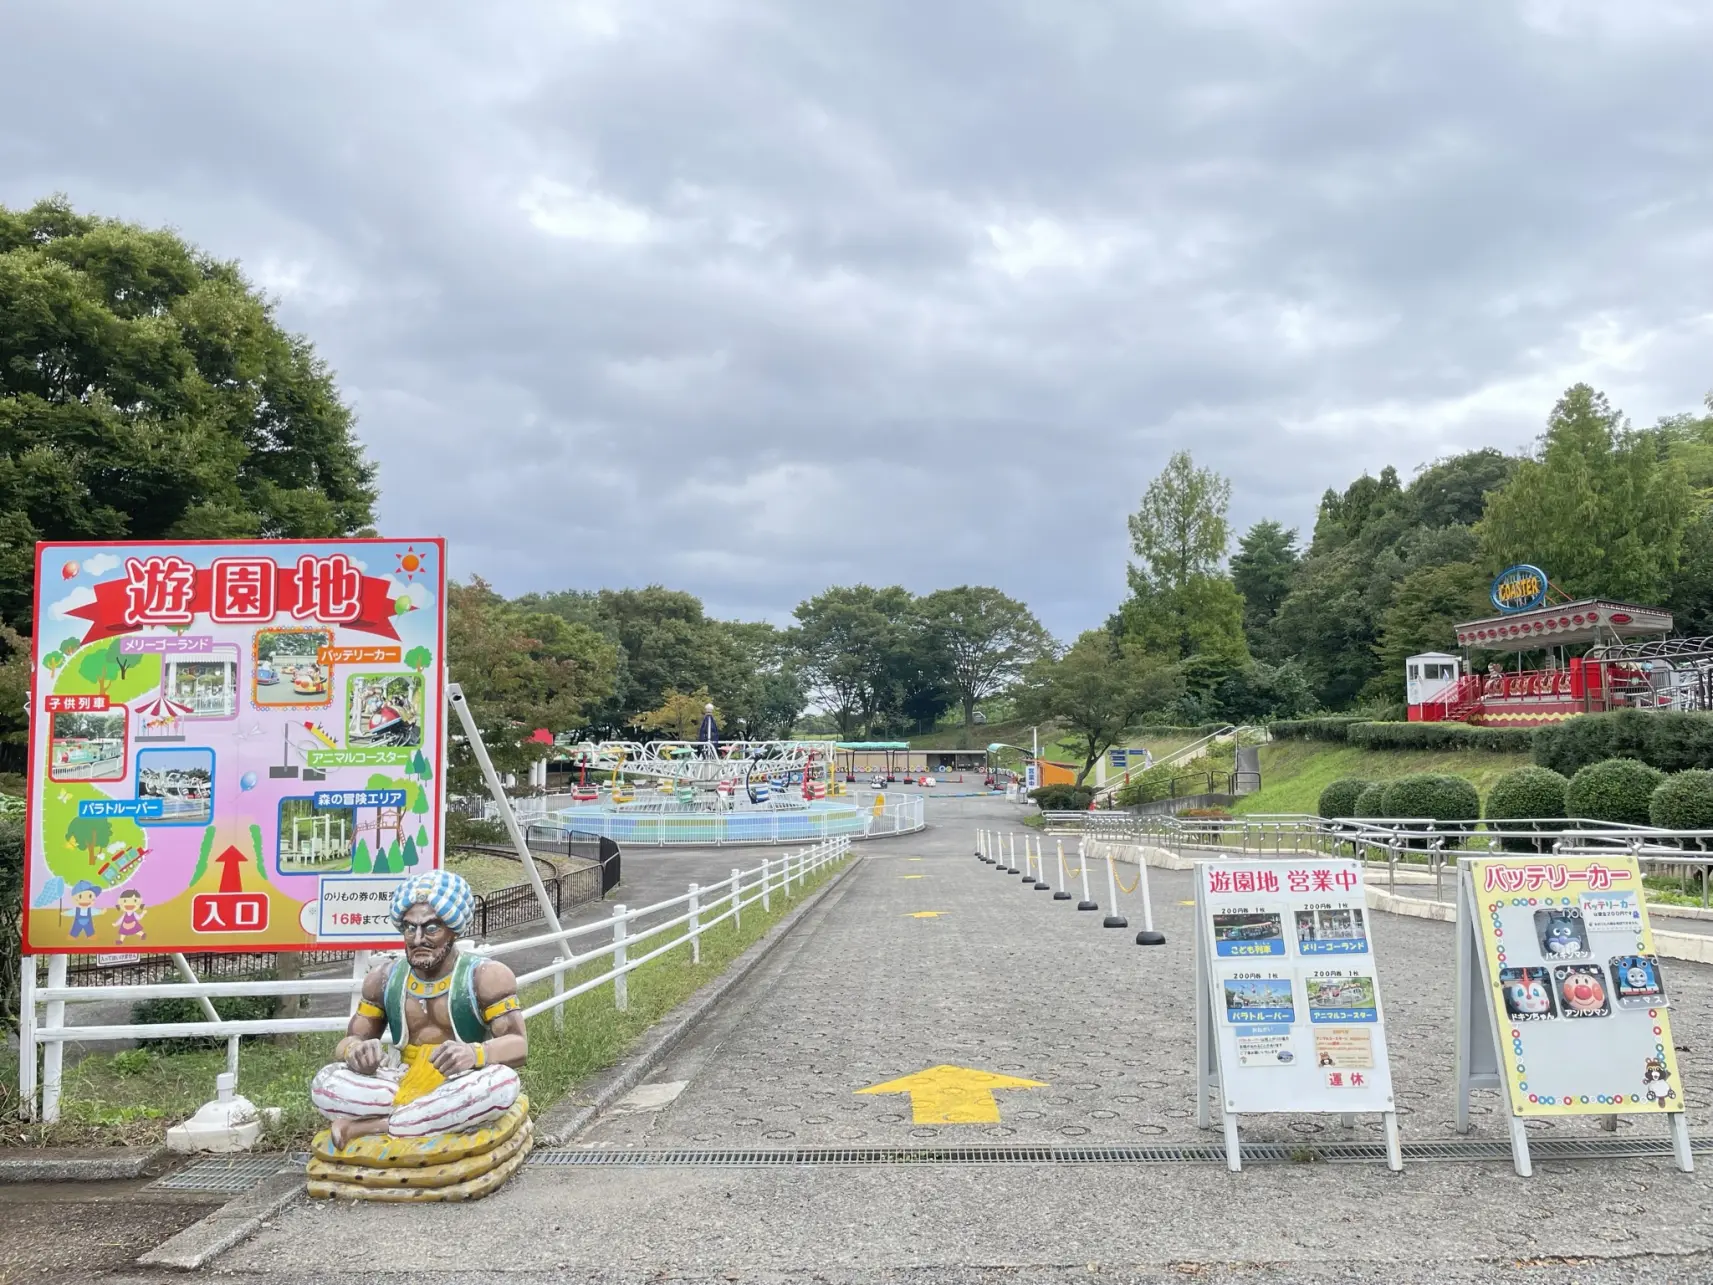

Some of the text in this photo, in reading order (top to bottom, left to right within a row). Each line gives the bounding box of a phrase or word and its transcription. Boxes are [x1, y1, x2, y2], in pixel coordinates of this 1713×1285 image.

[125, 555, 364, 625] 遊園地
[1498, 577, 1540, 601] COASTER
[125, 639, 208, 651] メリーゴーランド
[321, 649, 397, 661] バッテリーカー
[49, 697, 106, 710] 子供列車
[312, 752, 408, 764] アニマルコースター
[318, 792, 402, 805] 森の冒険エリア
[1208, 869, 1357, 893] 遊園地 営業中
[1485, 863, 1631, 892] バッテリーカー
[1584, 900, 1636, 910] バッテリーカー
[201, 901, 260, 927] 入口
[1303, 942, 1364, 951] メリーゴーランド
[1623, 996, 1662, 1005] トーマス
[1313, 1011, 1373, 1020] アニマルコースター
[1511, 1012, 1554, 1021] ドキンちゃん
[1565, 1009, 1608, 1017] アンパンマン
[1329, 1072, 1364, 1086] 運休
